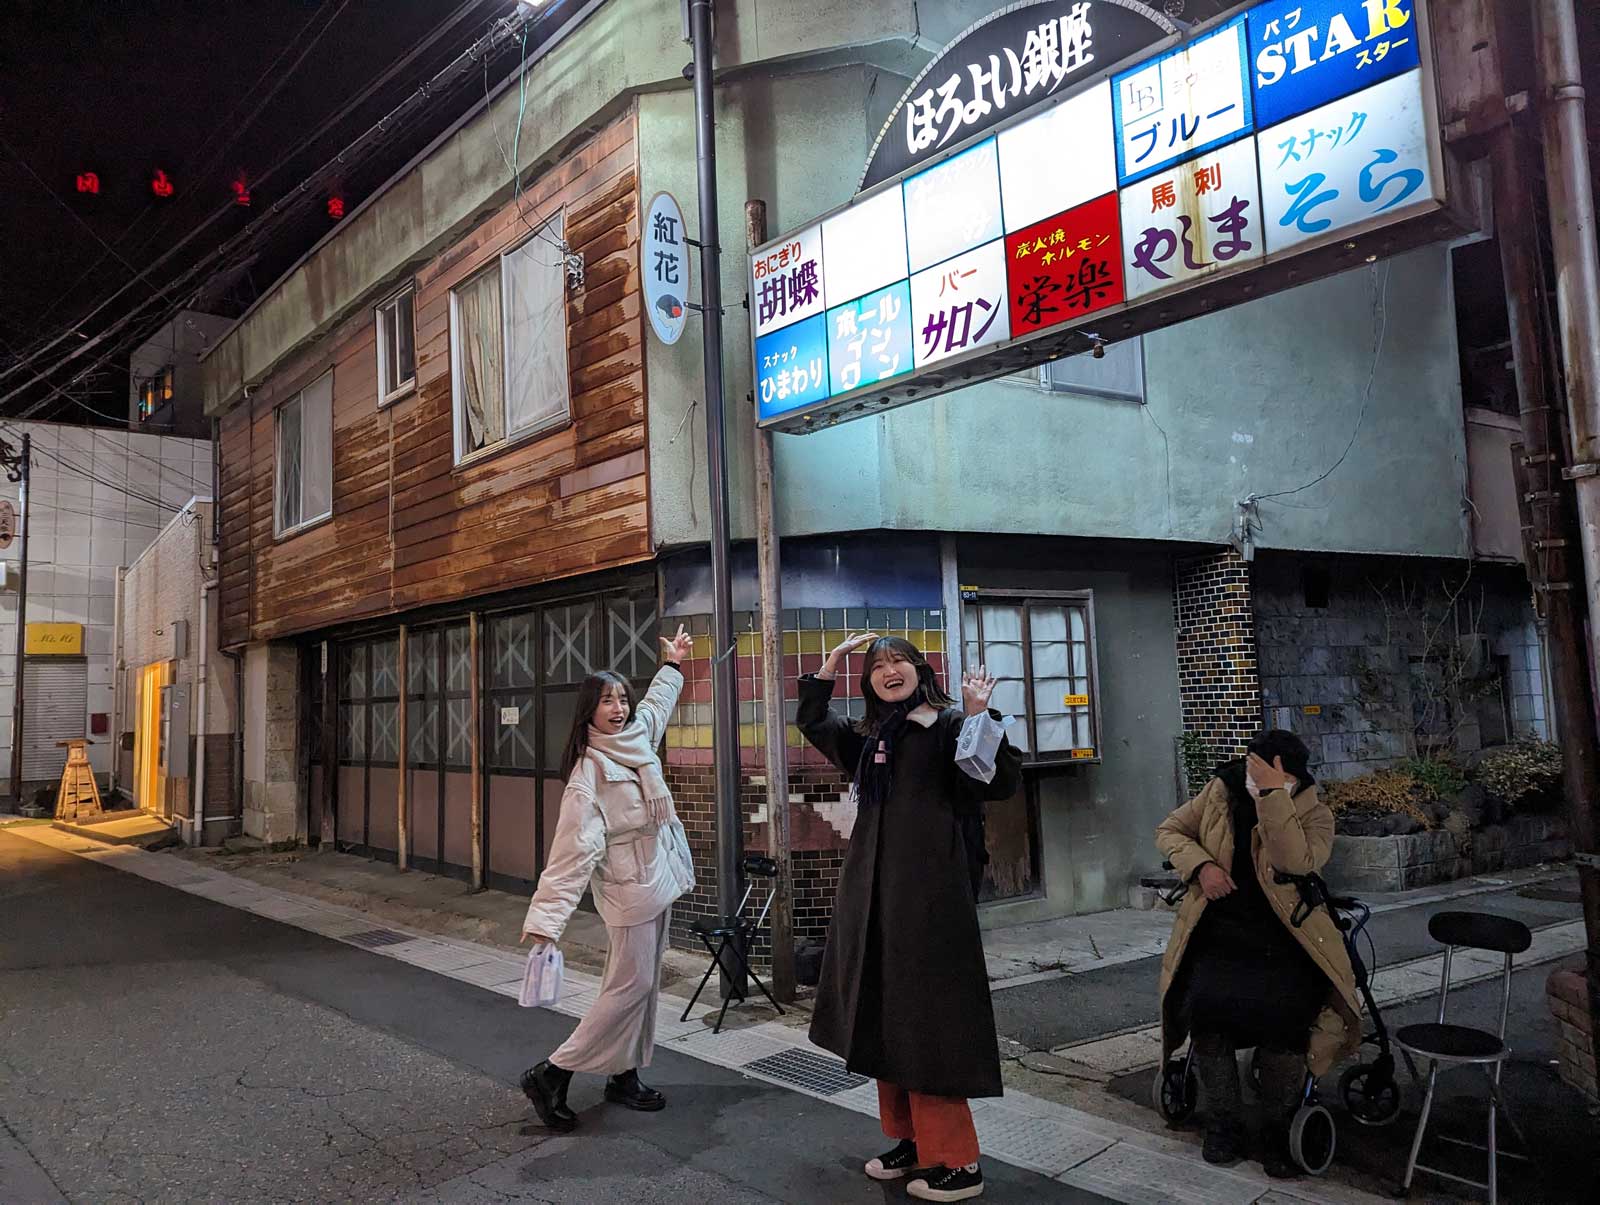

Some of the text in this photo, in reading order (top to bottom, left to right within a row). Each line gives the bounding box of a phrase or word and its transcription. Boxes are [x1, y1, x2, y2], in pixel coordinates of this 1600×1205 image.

[1256, 0, 1411, 89] STAR
[1355, 37, 1409, 70] スター
[906, 2, 1094, 154] ほろよい銀座
[1131, 104, 1236, 163] ブルー
[1276, 111, 1368, 169] スナック
[1151, 162, 1222, 213] 馬刺
[1279, 149, 1425, 233] そら
[654, 212, 679, 284] 紅花
[754, 241, 801, 280] おにぎり
[1016, 228, 1065, 259] 炭火焼
[1042, 234, 1110, 266] ホルモン
[1131, 196, 1252, 279] やしま
[757, 259, 819, 326] 胡蝶
[939, 268, 978, 297] バー
[835, 293, 901, 338] ホール
[922, 292, 1002, 360] サロン
[763, 345, 797, 368] スナック
[847, 327, 892, 356] イン
[761, 355, 823, 403] ひまわり
[840, 351, 899, 389] ワン
